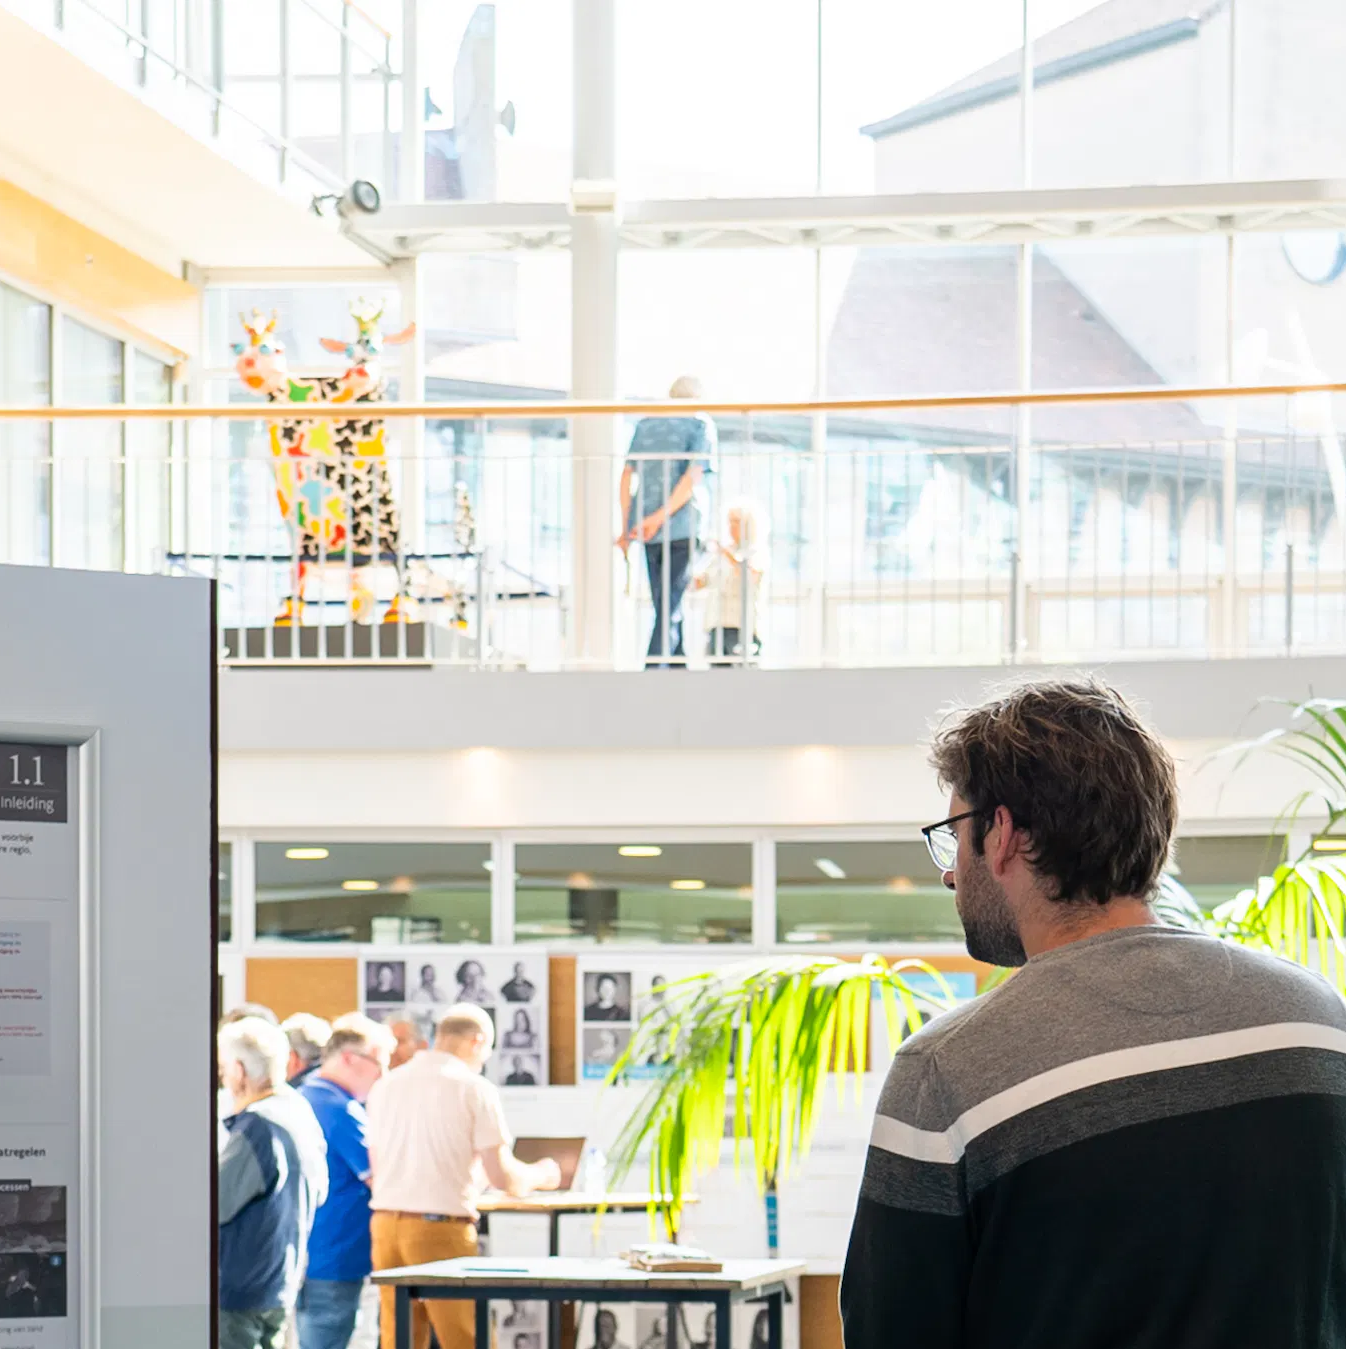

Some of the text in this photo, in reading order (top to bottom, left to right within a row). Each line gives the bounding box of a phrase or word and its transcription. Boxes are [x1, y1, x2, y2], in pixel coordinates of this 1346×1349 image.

[9, 754, 45, 786] 1.1
[0, 795, 55, 815] Inleiding
[1, 833, 34, 843] voorbije
